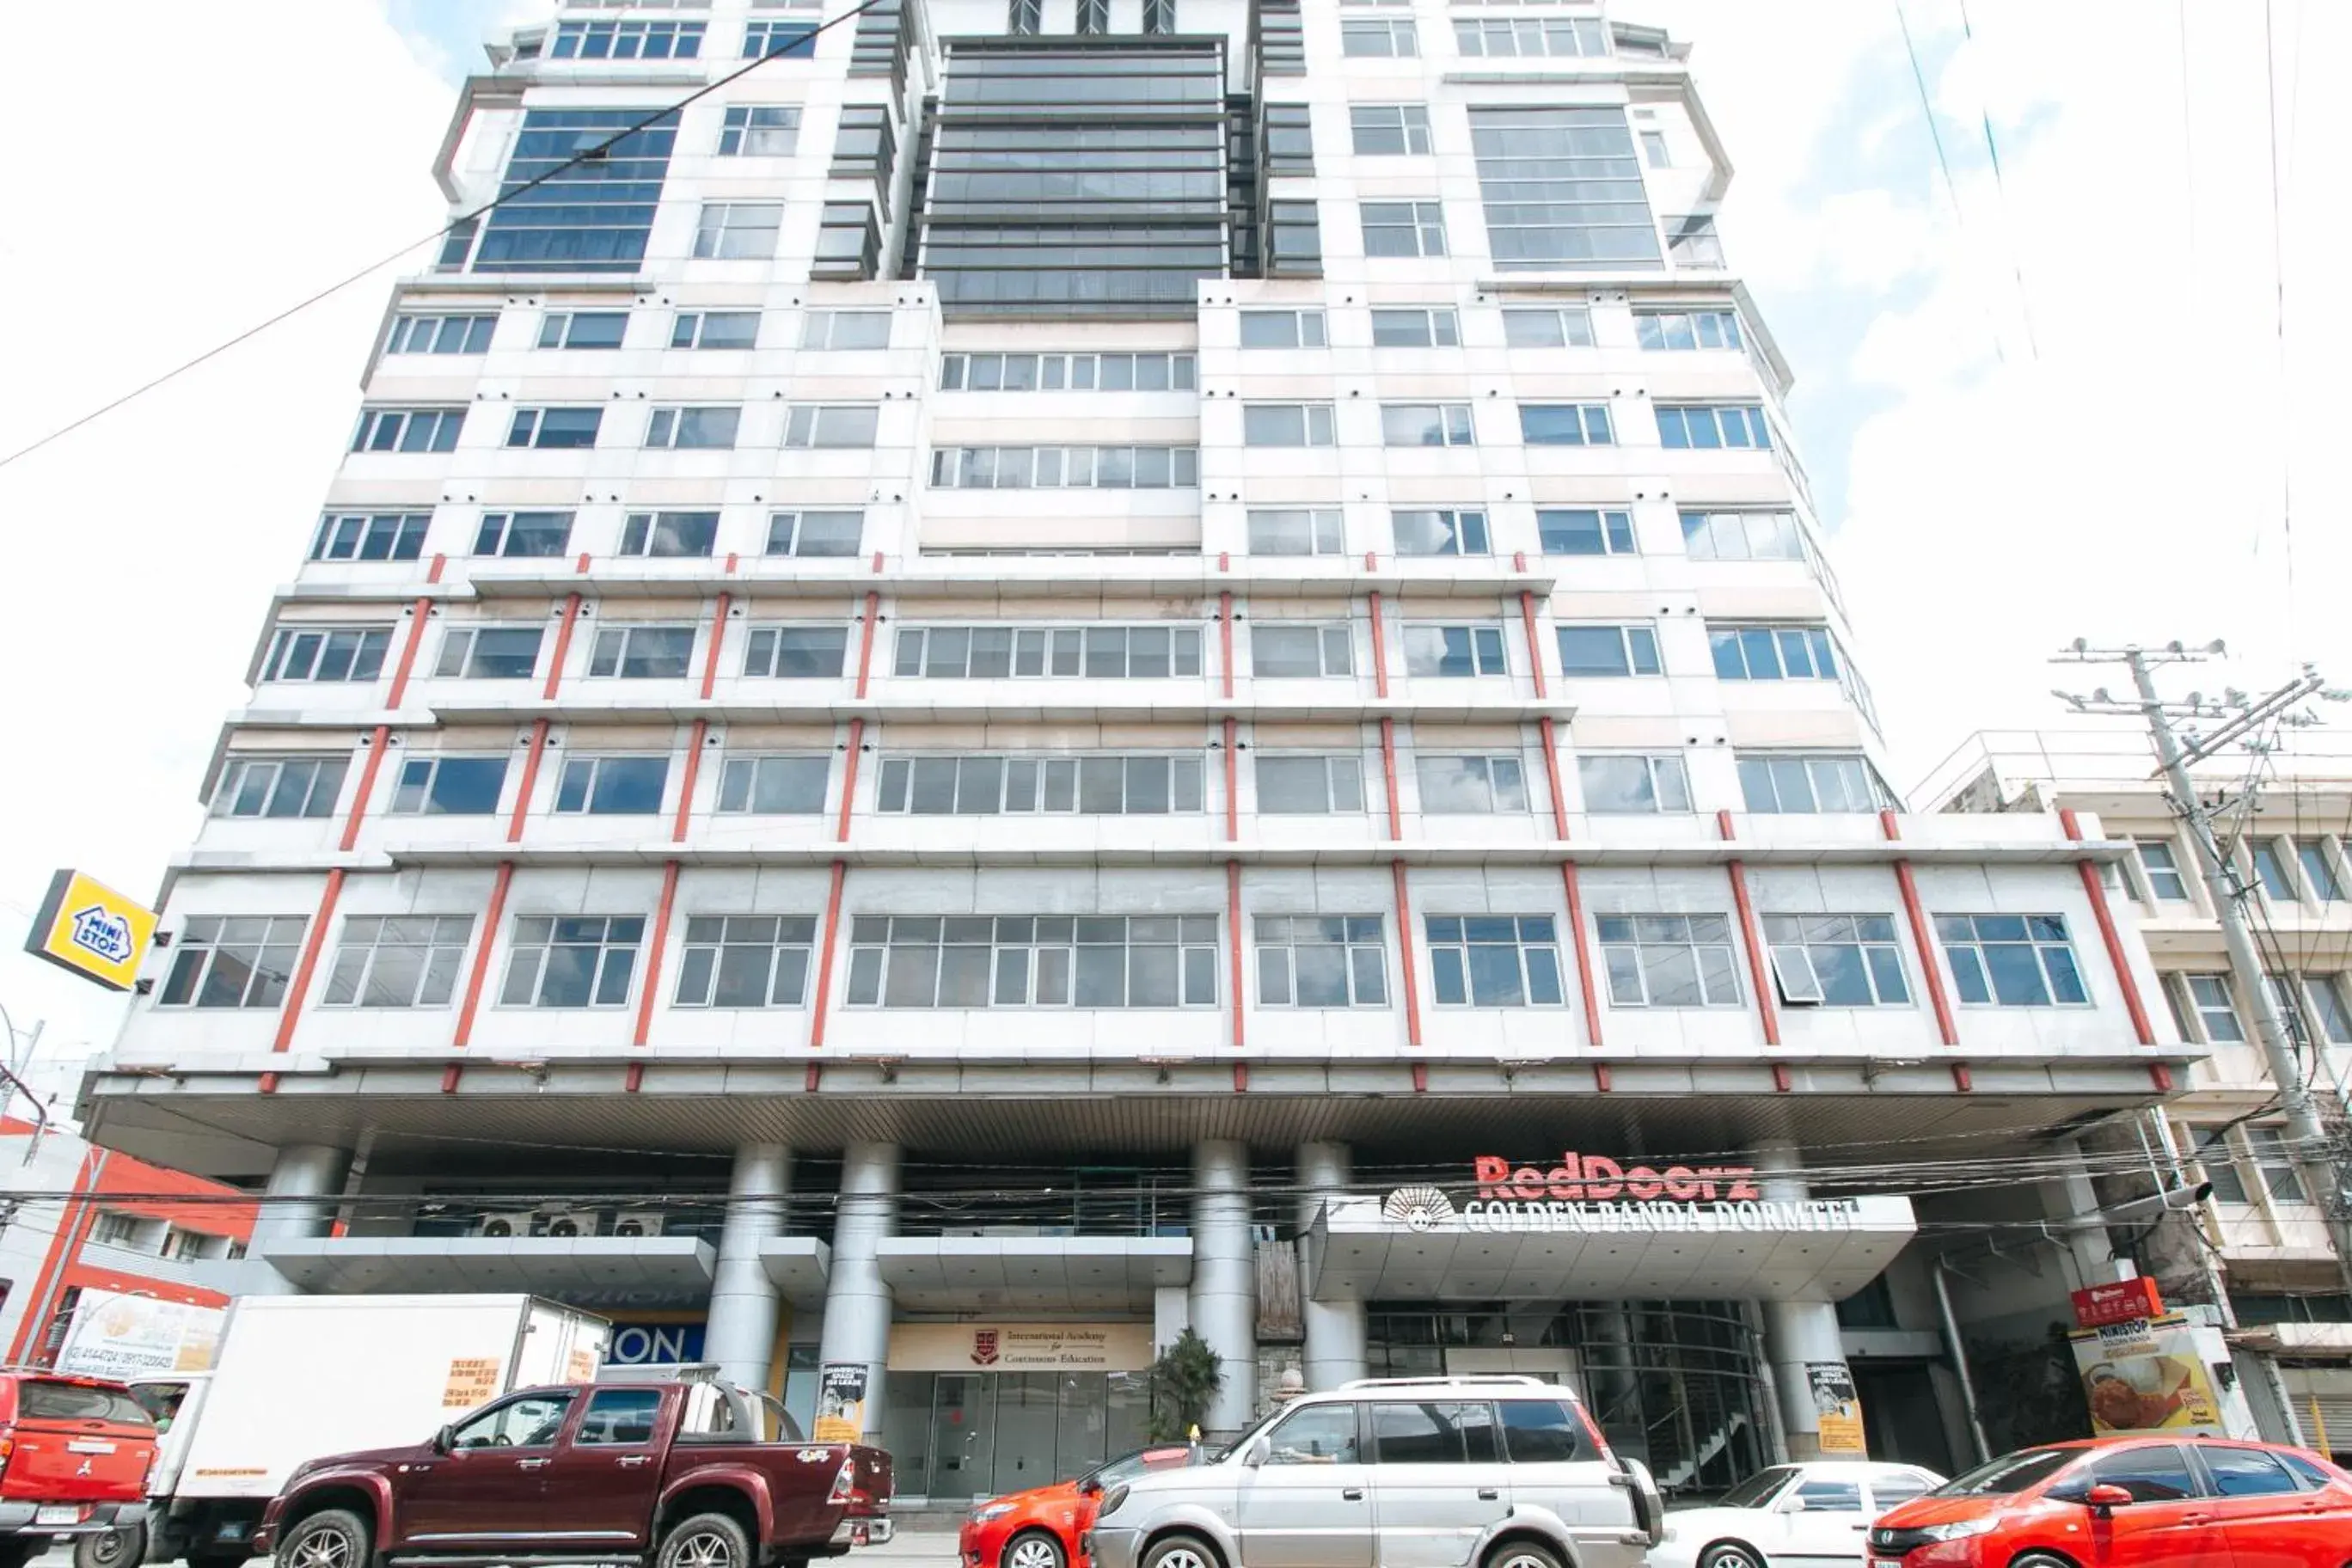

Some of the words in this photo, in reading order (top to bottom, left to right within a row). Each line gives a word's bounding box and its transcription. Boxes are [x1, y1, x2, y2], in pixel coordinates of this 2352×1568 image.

[81, 928, 119, 952] STOP
[89, 916, 122, 941] MINI
[1474, 1152, 1760, 1200] RedDoorz
[1464, 1200, 1592, 1233] GOLDEN
[1596, 1200, 1701, 1233] PANDA
[1712, 1199, 1860, 1232] DORMTEL
[1008, 1332, 1064, 1341] International
[1066, 1332, 1106, 1343] Academy
[1005, 1354, 1057, 1363] Continuous
[1060, 1354, 1106, 1363] Education
